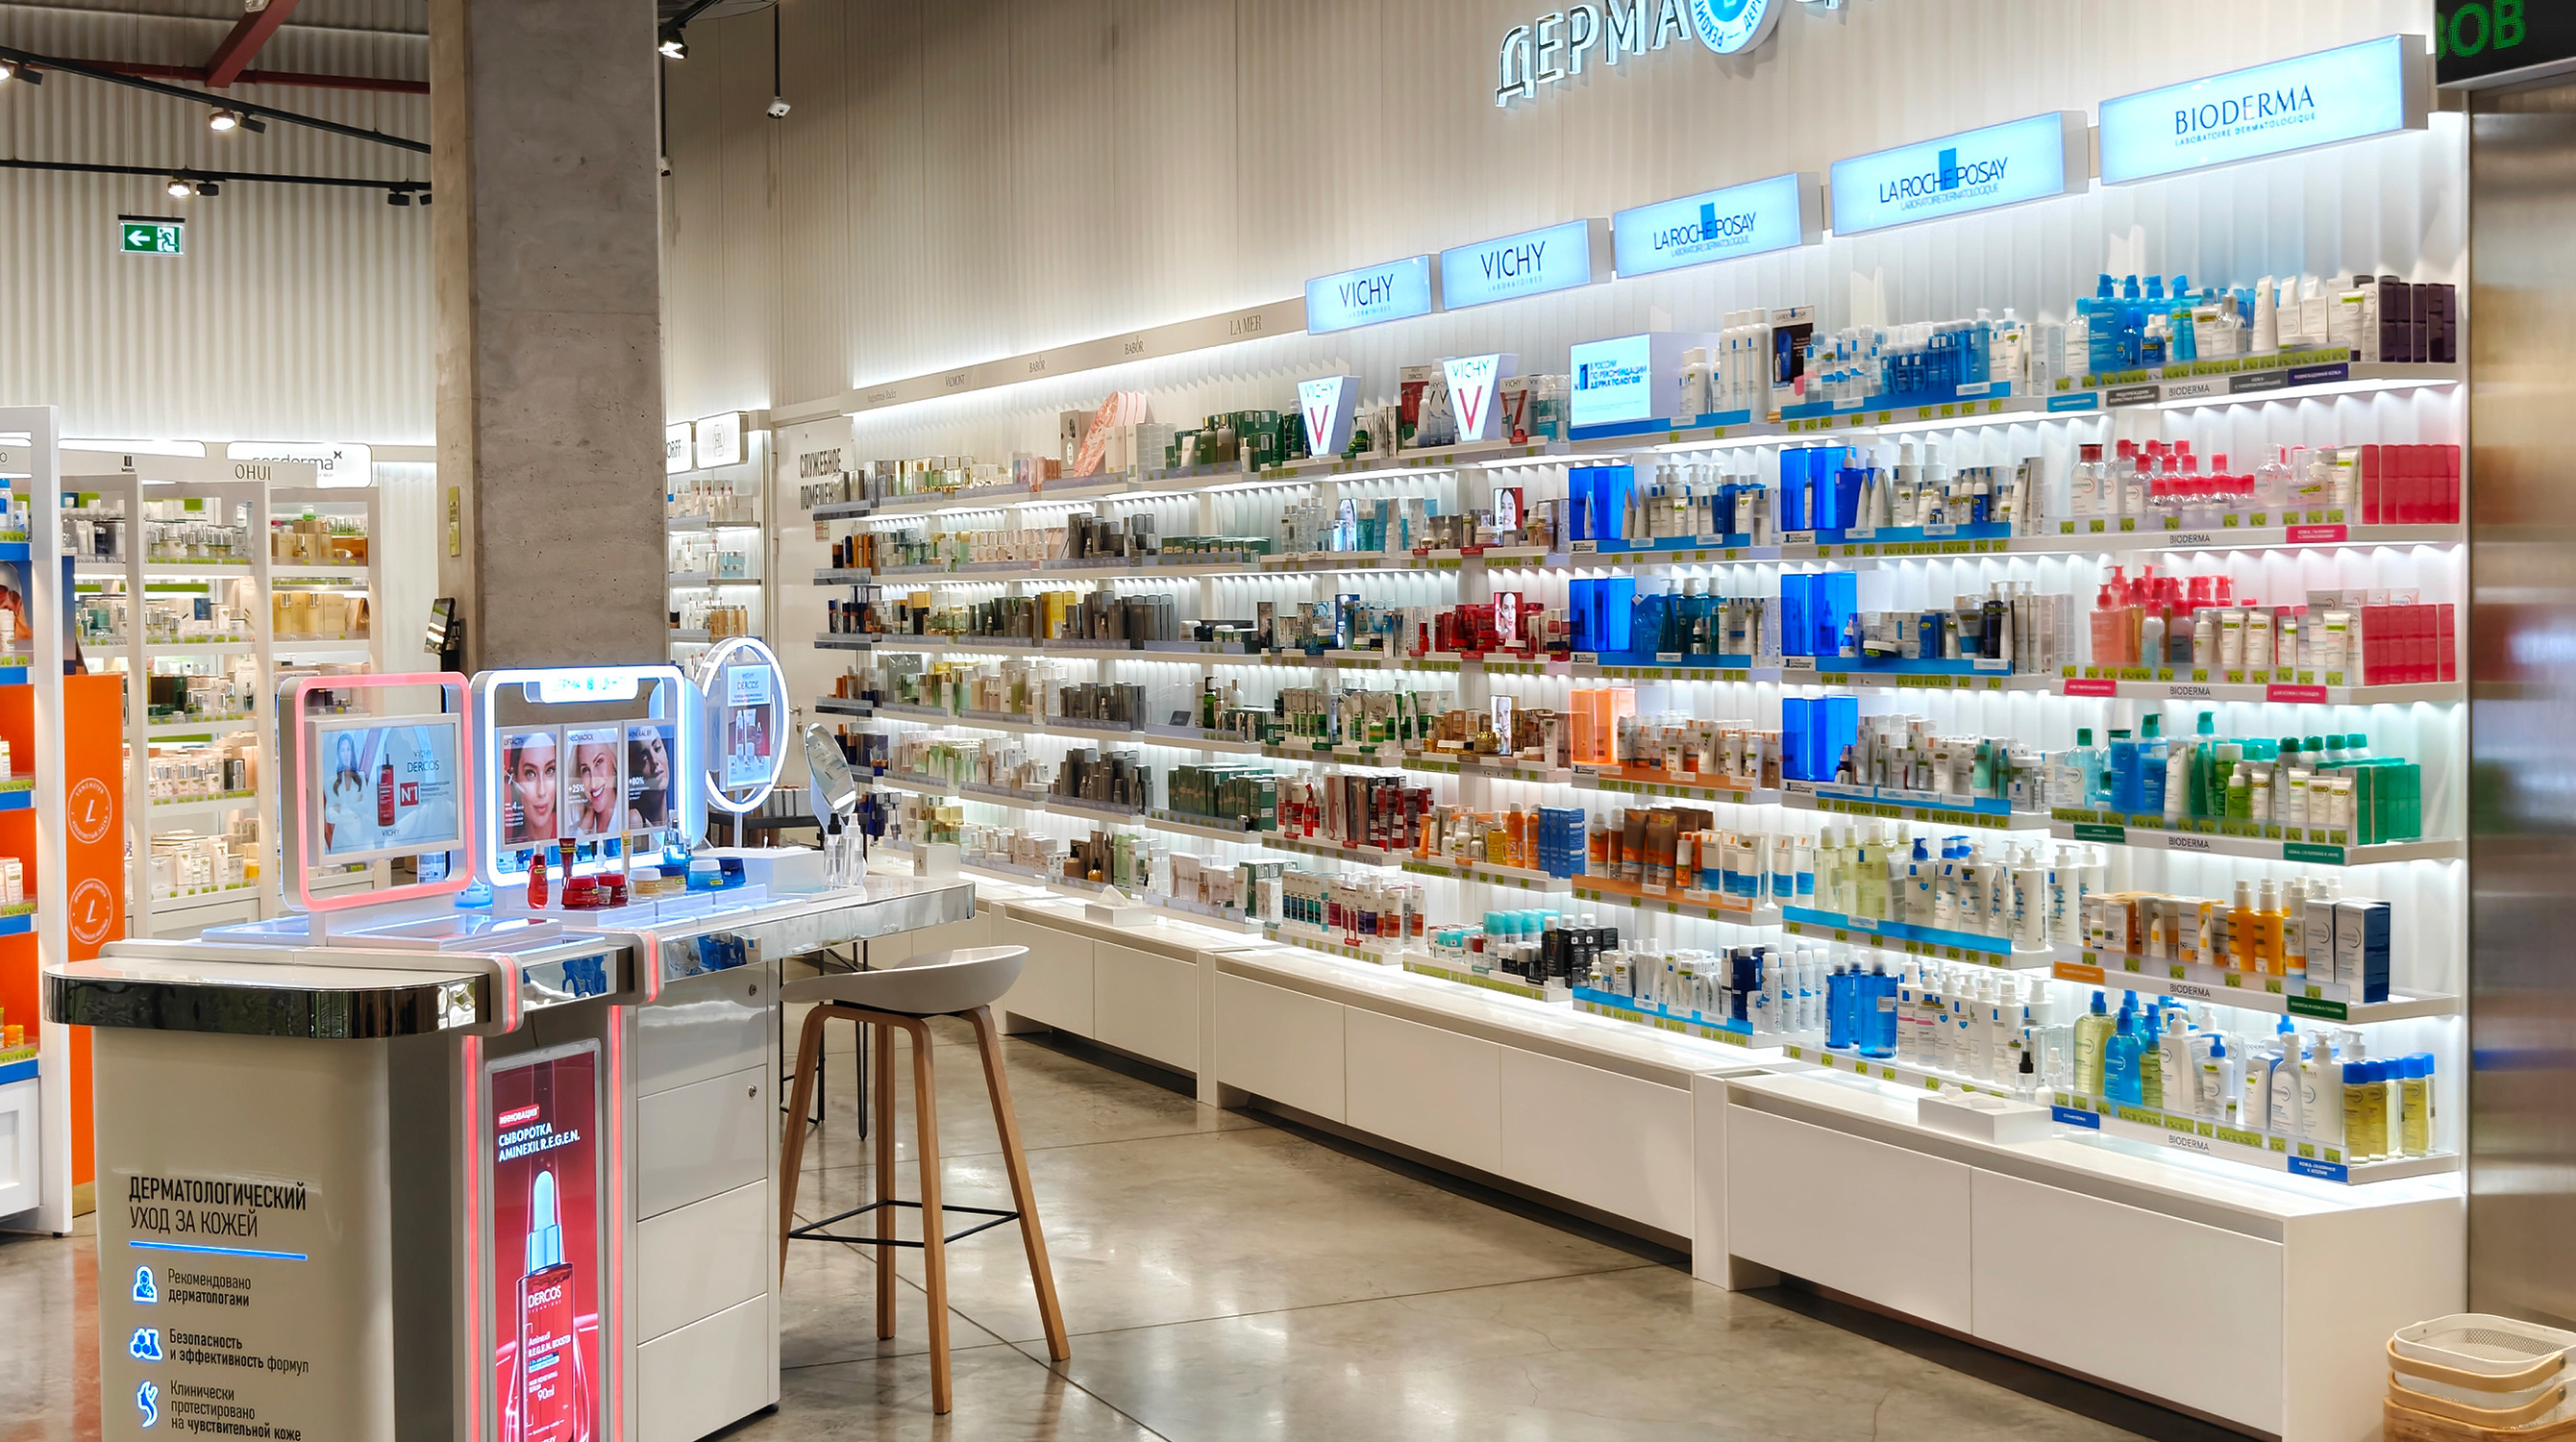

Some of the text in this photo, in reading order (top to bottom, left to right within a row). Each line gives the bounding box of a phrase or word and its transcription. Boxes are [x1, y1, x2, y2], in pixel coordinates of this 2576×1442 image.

[2175, 85, 2315, 135] BIODERMA
[2175, 129, 2231, 146] LABORATOIRE
[1480, 240, 1547, 281] VICHY
[1339, 273, 1395, 308] VICHY
[1228, 314, 1262, 336] LA MER
[1452, 360, 1490, 379] VICHY
[2168, 385, 2210, 397] BIODERMA
[235, 463, 271, 481] OHUI
[2169, 534, 2211, 544] BIODERMA
[2169, 685, 2211, 696] BIODERMA
[408, 760, 440, 773] DERCOS
[2168, 836, 2210, 849] BIODERMA
[2169, 982, 2211, 998] BIODERMA
[498, 1123, 553, 1147] СЫВОРОТКА
[498, 1129, 581, 1162] AMINEXIL R.E.G.E.N.
[2168, 1134, 2210, 1152] BIODERMA
[129, 1177, 307, 1210] ДЕРМАТОЛОГИЧЕСКИЙ
[130, 1206, 258, 1237] УХОД ЗА КОЖЕЙ
[168, 1268, 252, 1290] Рекомендовано
[168, 1288, 250, 1306] дерматологами
[529, 1285, 561, 1308] DERCOS
[169, 1329, 243, 1350] Безопасность
[170, 1348, 310, 1376] и эффективность формул
[170, 1380, 235, 1401] Клинически
[171, 1401, 256, 1420] протестировано
[171, 1417, 302, 1442] на чувствительной коже
